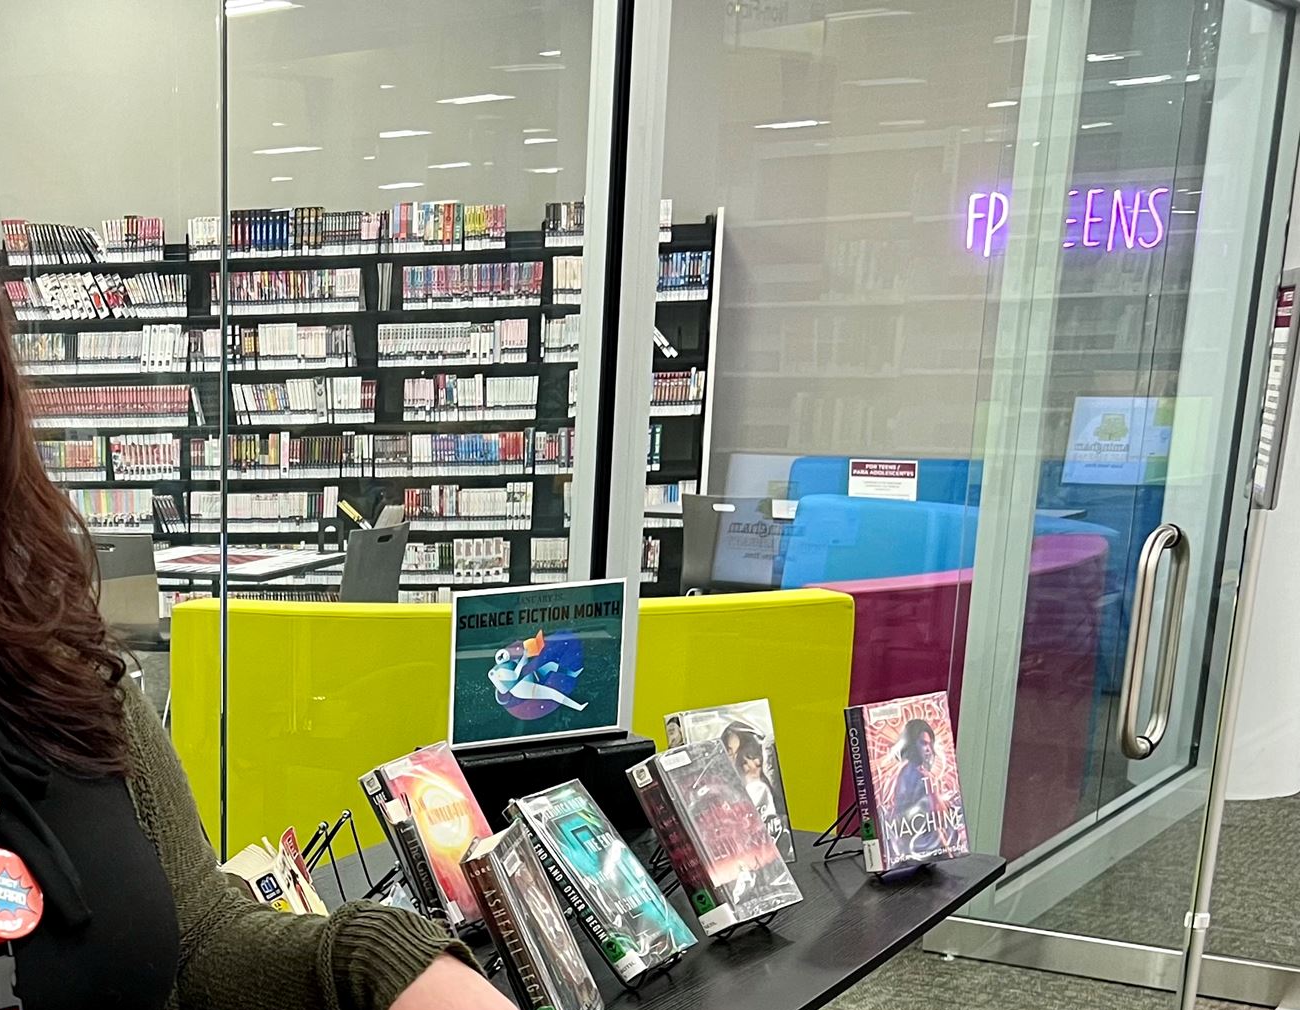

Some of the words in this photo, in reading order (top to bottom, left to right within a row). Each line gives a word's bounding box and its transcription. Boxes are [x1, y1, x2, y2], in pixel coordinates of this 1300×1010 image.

[966, 191, 1010, 258] FP
[1063, 187, 1169, 252] EENS
[458, 610, 514, 631] SCIENCE
[518, 605, 570, 625] FICTION
[573, 599, 621, 619] MONTH
[850, 727, 863, 776] GODDESS
[859, 788, 868, 806] THE
[922, 776, 947, 795] THE
[885, 810, 964, 840] MACHINE
[406, 837, 421, 860] The
[415, 860, 434, 893] Giver
[470, 866, 491, 878] LORE
[533, 842, 548, 862] END
[547, 864, 564, 882] AND
[563, 885, 585, 913] OTHER
[585, 915, 610, 943] BEGIN
[483, 889, 522, 961] ASHFALL
[517, 966, 544, 1004] LEGA
